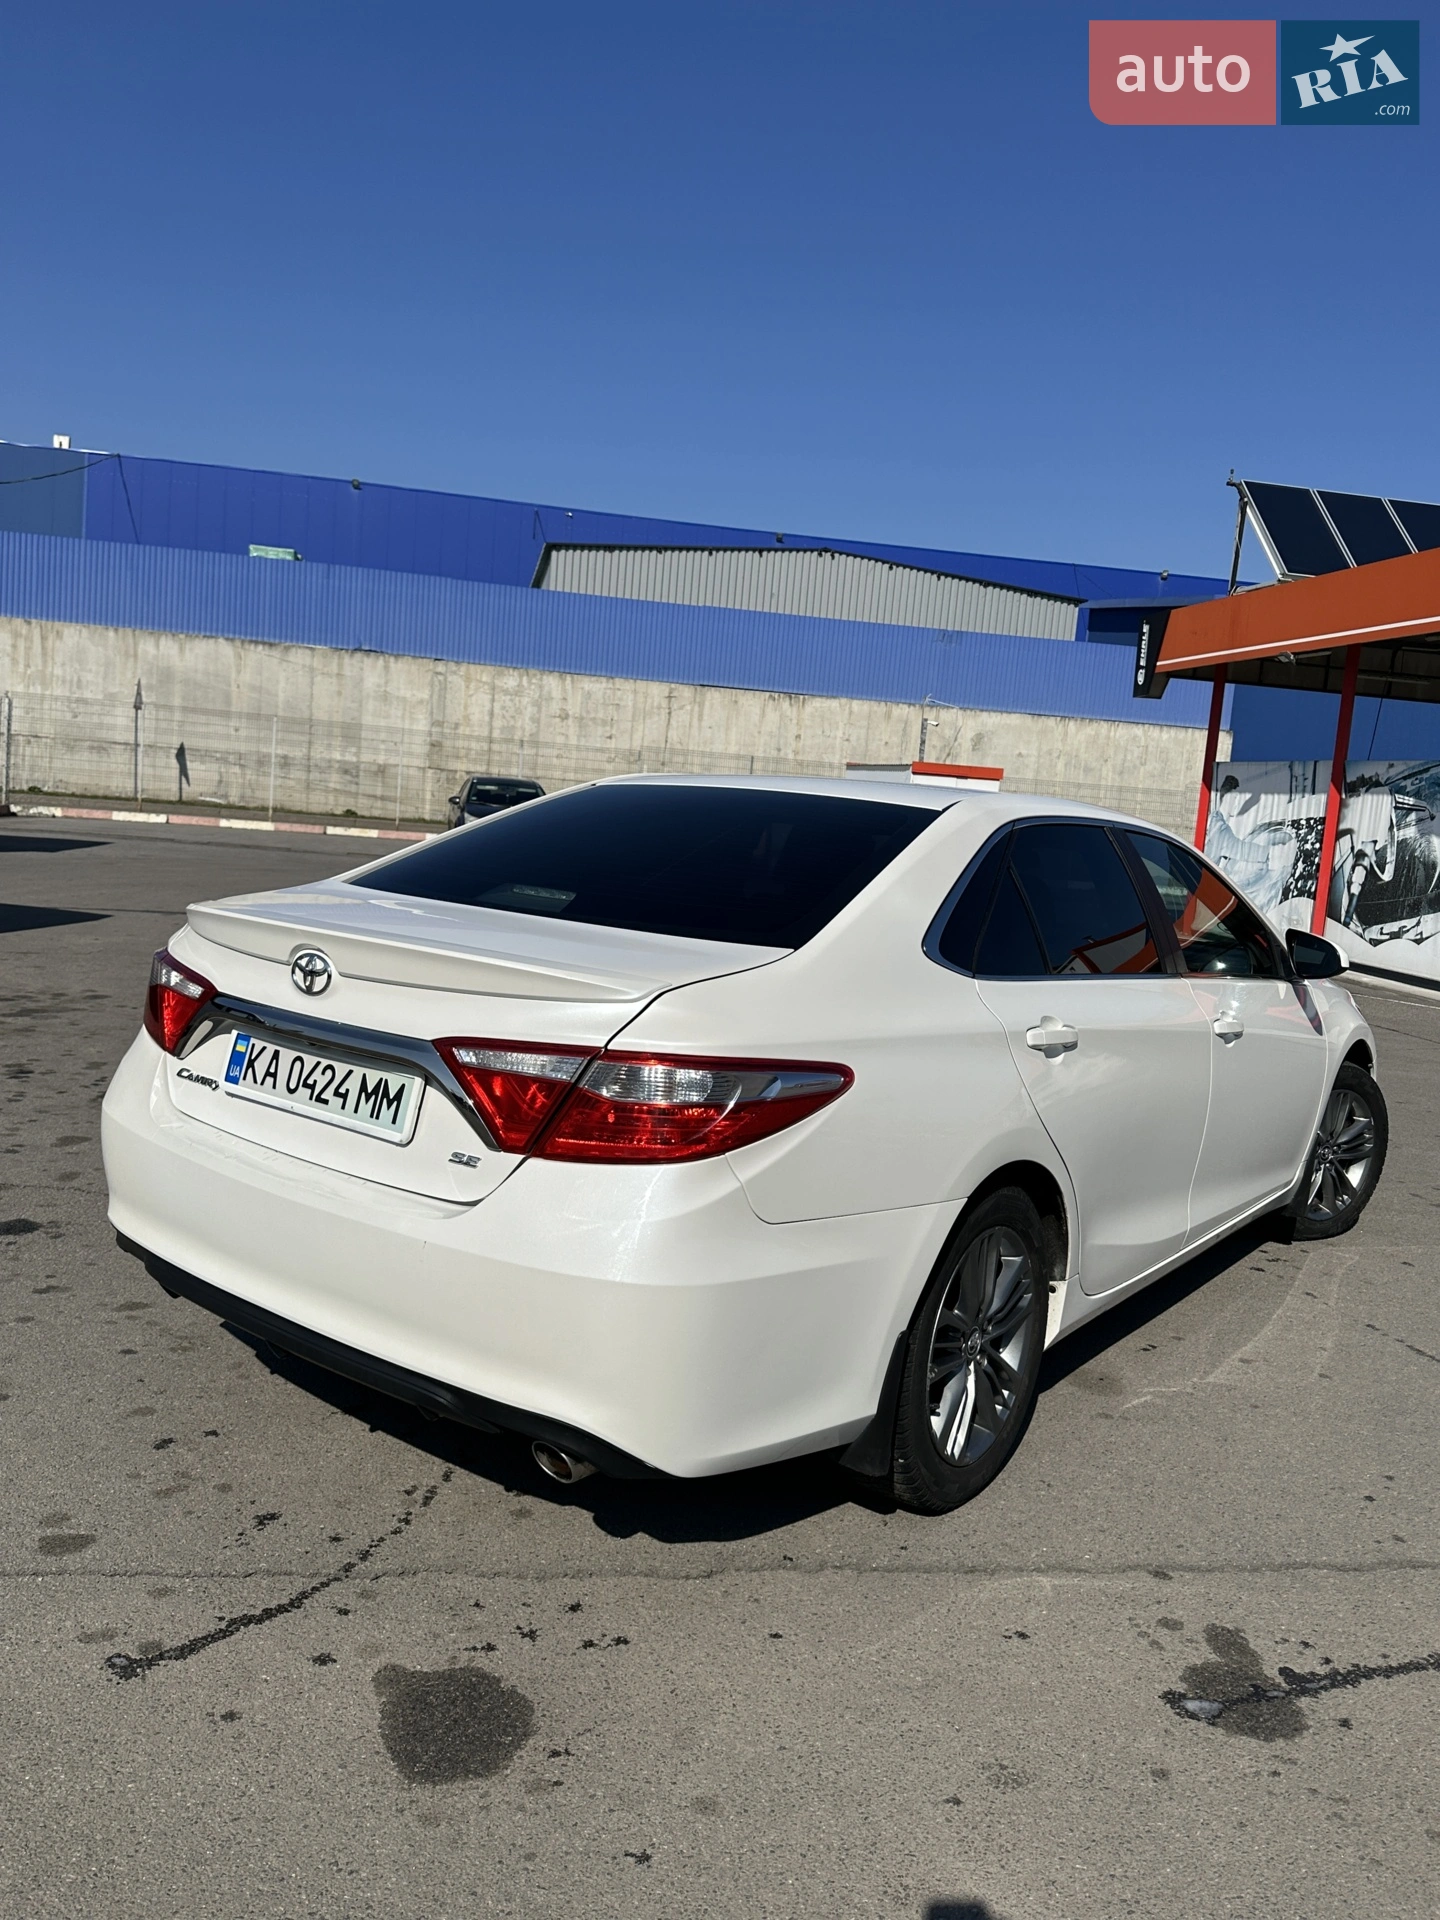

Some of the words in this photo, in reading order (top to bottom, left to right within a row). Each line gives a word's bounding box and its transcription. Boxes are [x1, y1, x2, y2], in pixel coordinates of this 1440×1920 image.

[176, 1067, 220, 1091] CAMRY
[229, 1064, 240, 1078] UA
[242, 1042, 281, 1090] KA
[285, 1055, 354, 1111] 0424
[353, 1072, 407, 1125] MM
[448, 1151, 482, 1169] SE
